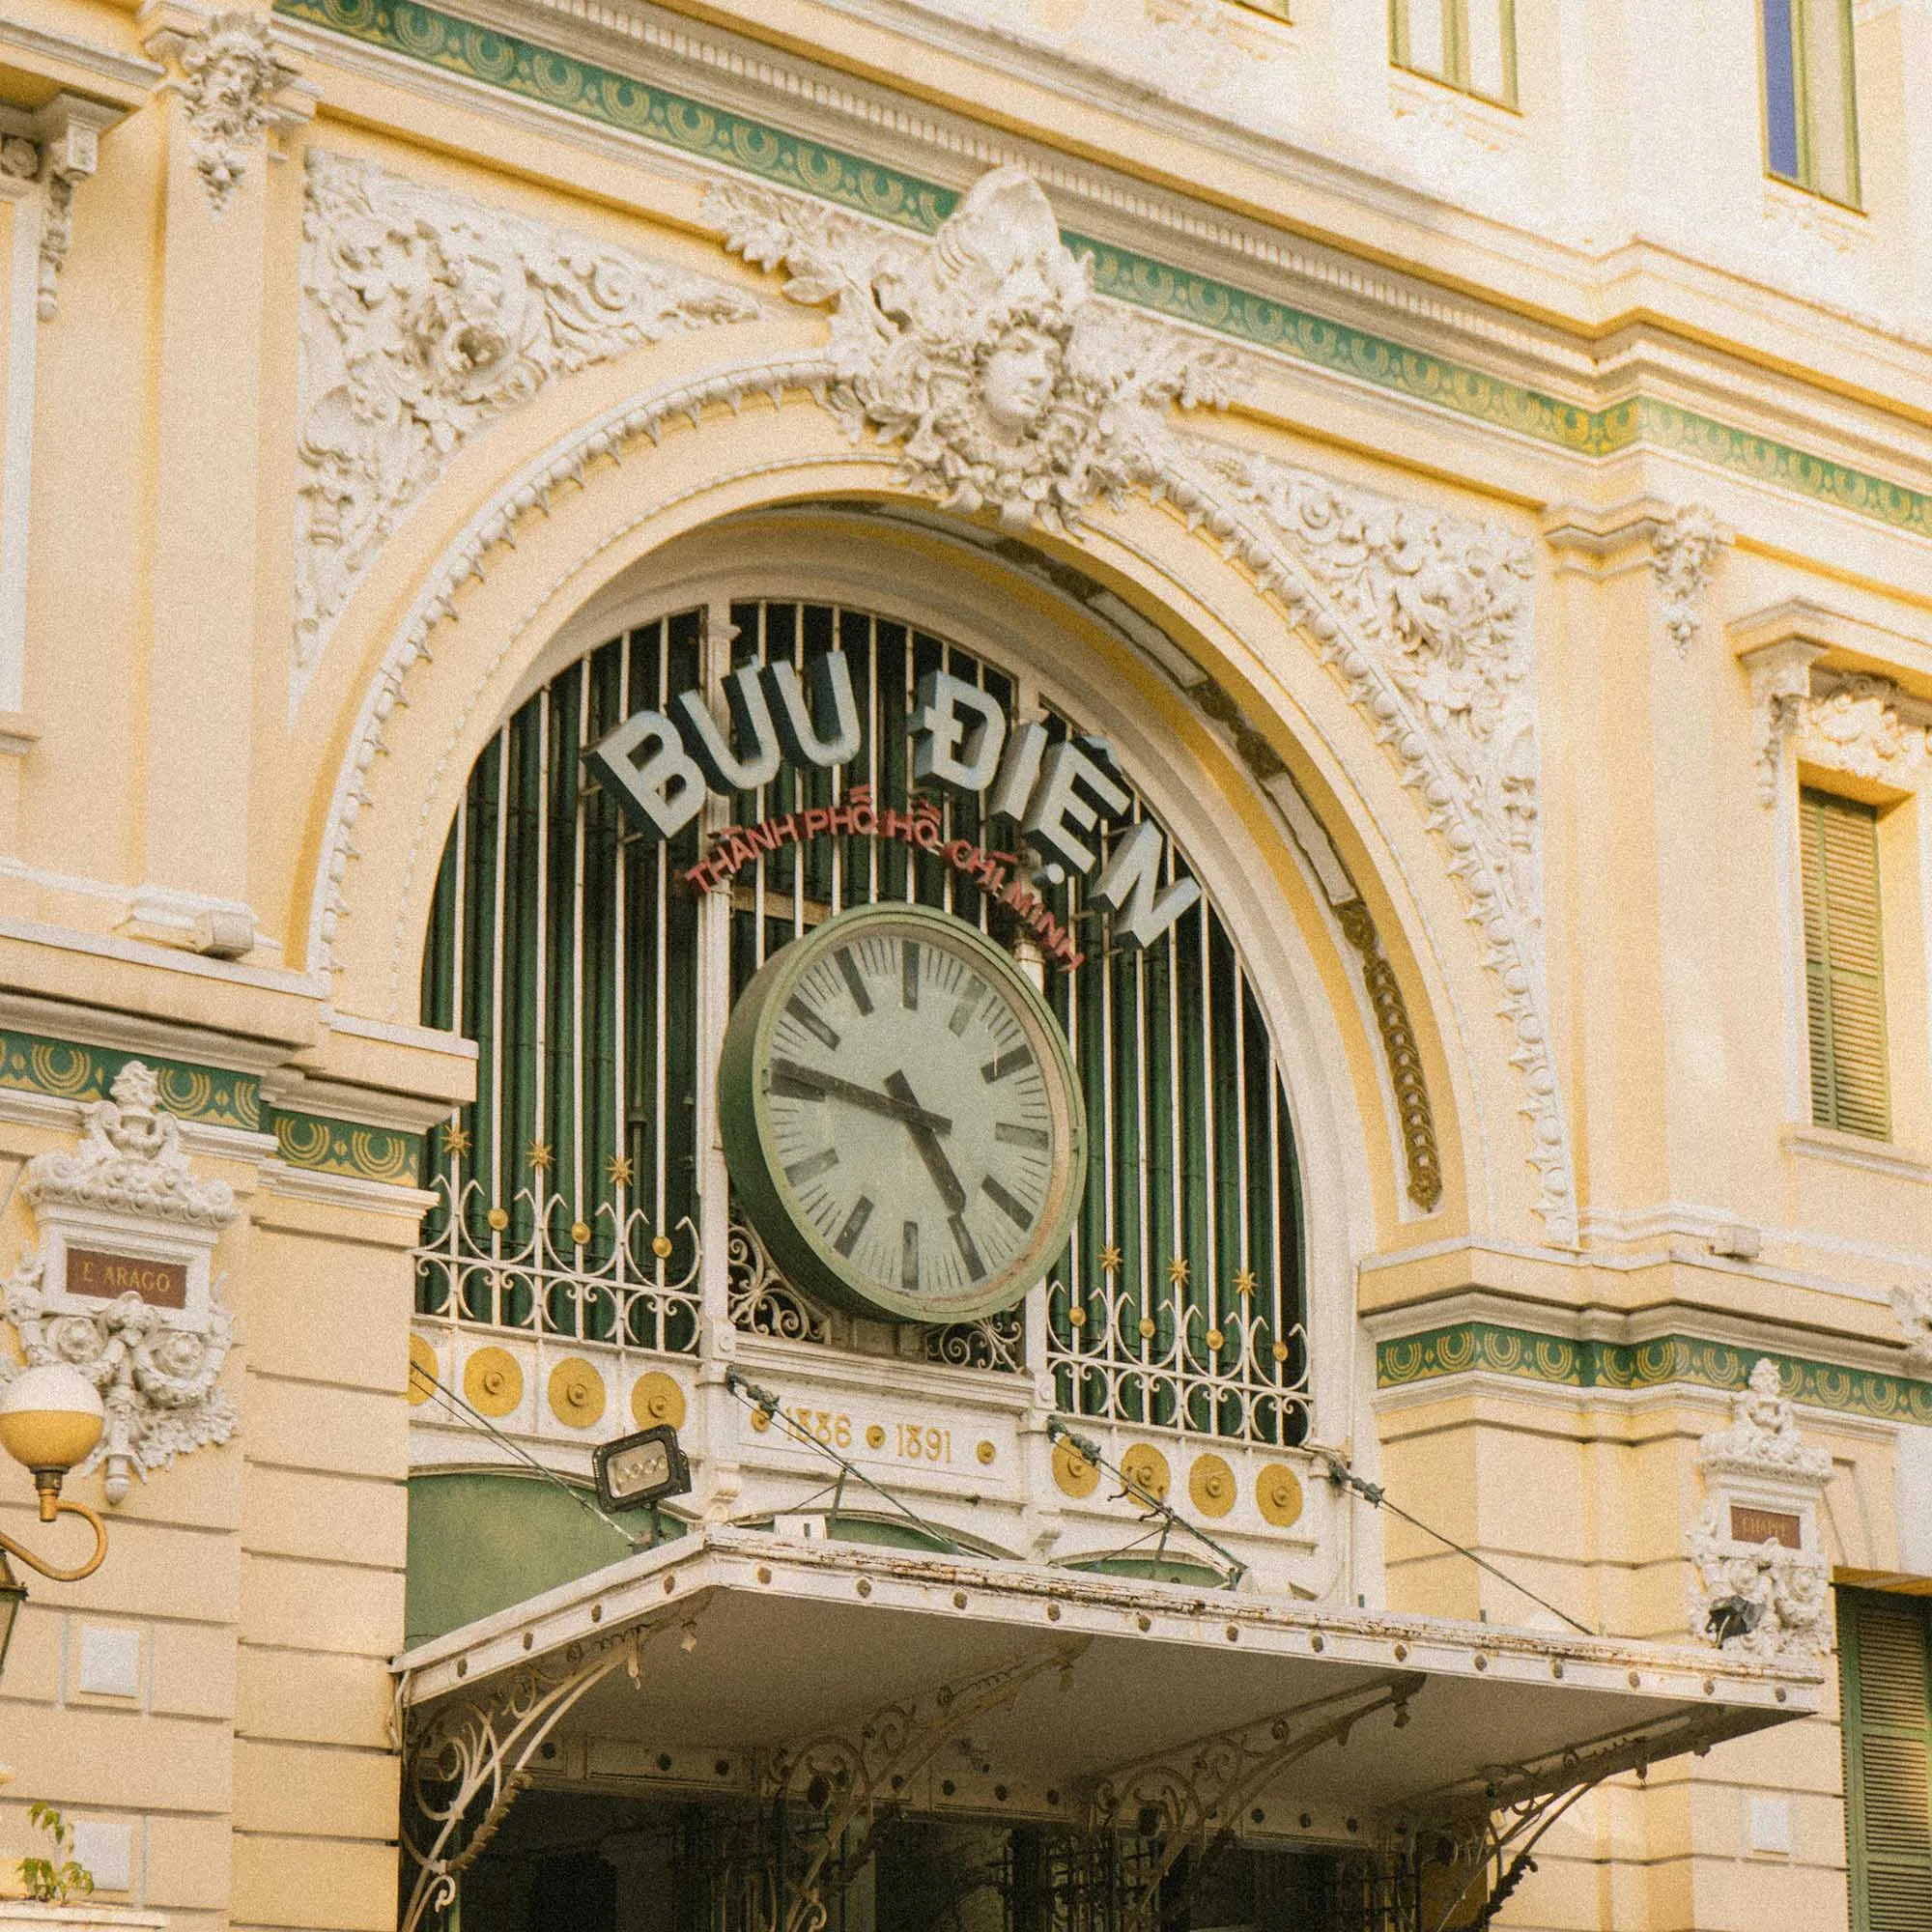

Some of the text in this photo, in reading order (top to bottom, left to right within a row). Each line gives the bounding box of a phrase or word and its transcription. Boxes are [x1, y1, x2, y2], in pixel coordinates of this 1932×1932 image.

[918, 670, 1203, 950] ĐIỆN
[684, 823, 800, 895] THÀNH
[803, 783, 878, 839] PHỐ
[879, 797, 943, 842] HỒ
[1005, 880, 1085, 974] MINH
[103, 1265, 171, 1293] ARAGO
[785, 1406, 852, 1449] 1886
[895, 1422, 952, 1463] 1891
